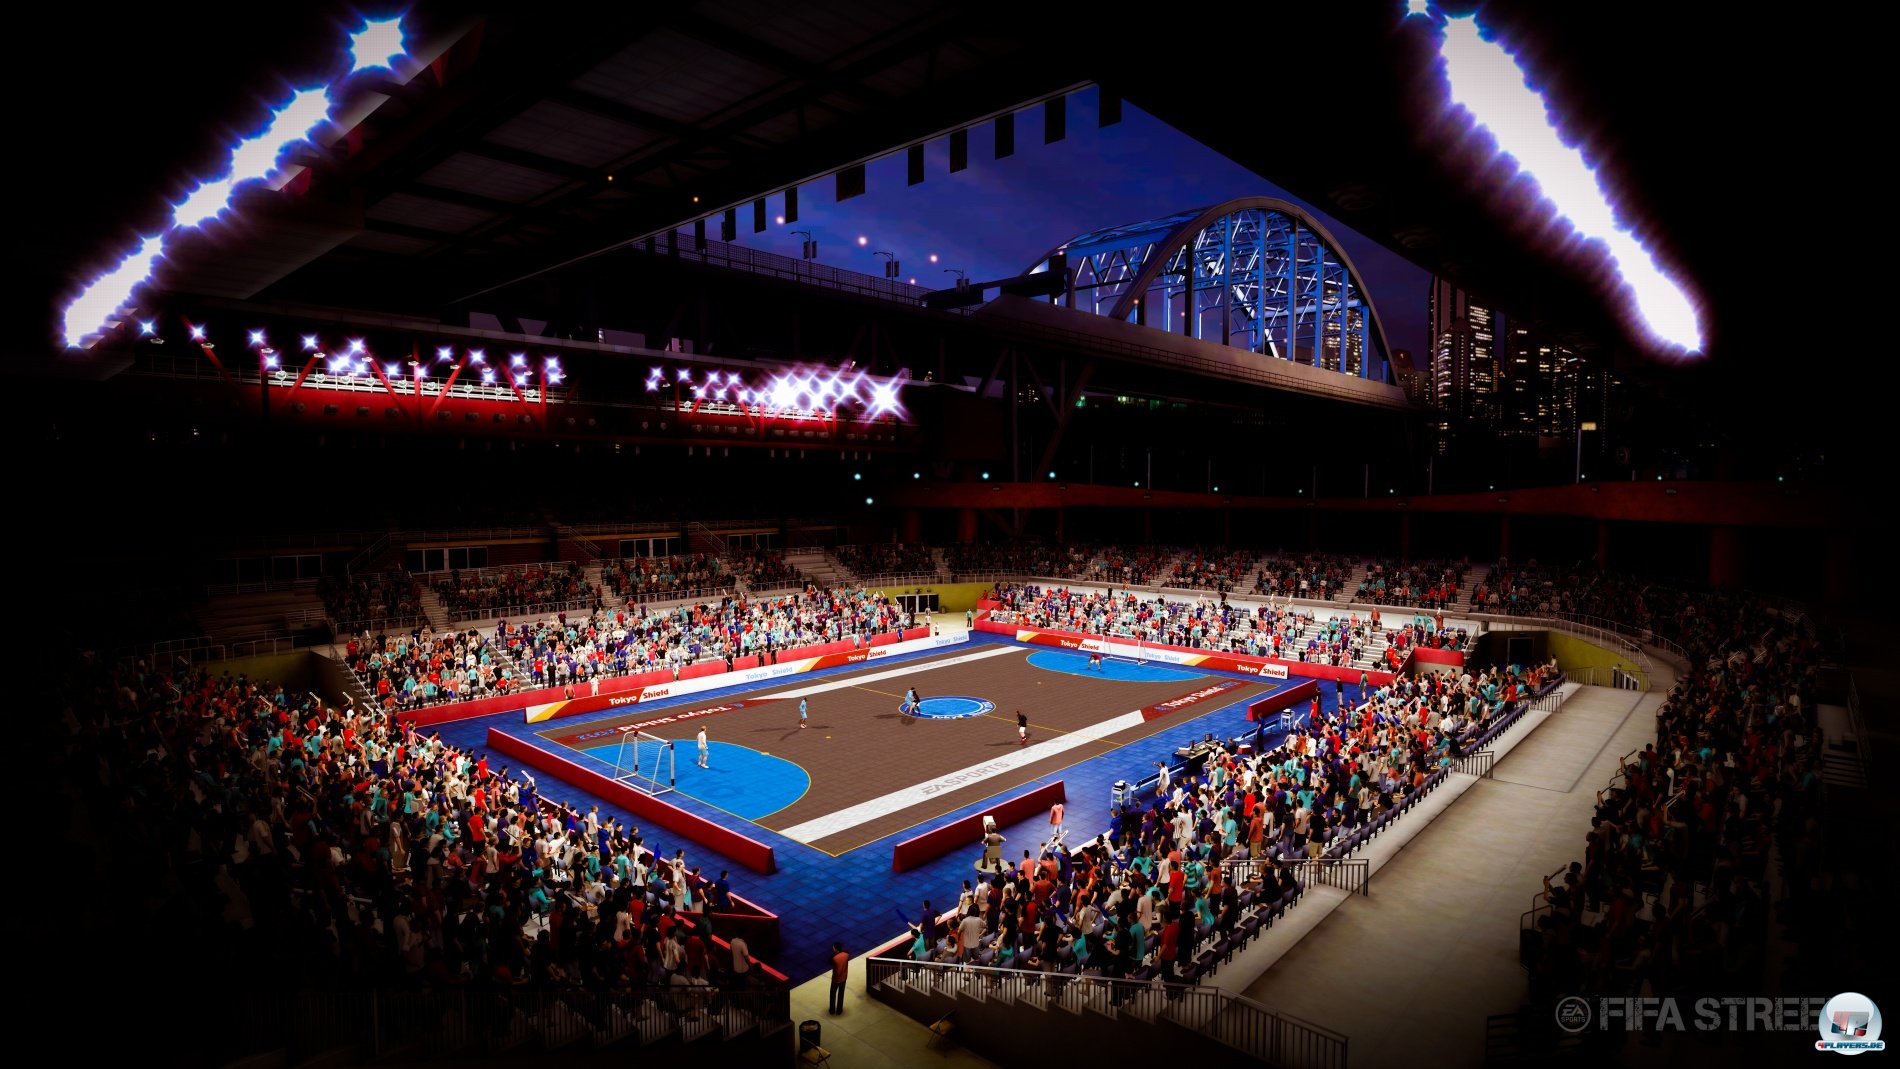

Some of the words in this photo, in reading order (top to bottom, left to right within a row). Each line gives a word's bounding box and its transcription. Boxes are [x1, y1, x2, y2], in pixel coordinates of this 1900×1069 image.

[1060, 639, 1078, 648] Tokyo
[1081, 643, 1100, 651] Shield
[848, 654, 866, 662] Tokyo
[869, 650, 887, 658] Shield
[745, 672, 768, 680] Tokyo
[771, 666, 793, 676] Shield
[1237, 664, 1259, 673] Tokyo
[1262, 668, 1285, 677] Shield
[609, 695, 637, 706] Tokyo
[642, 689, 669, 699] Shield
